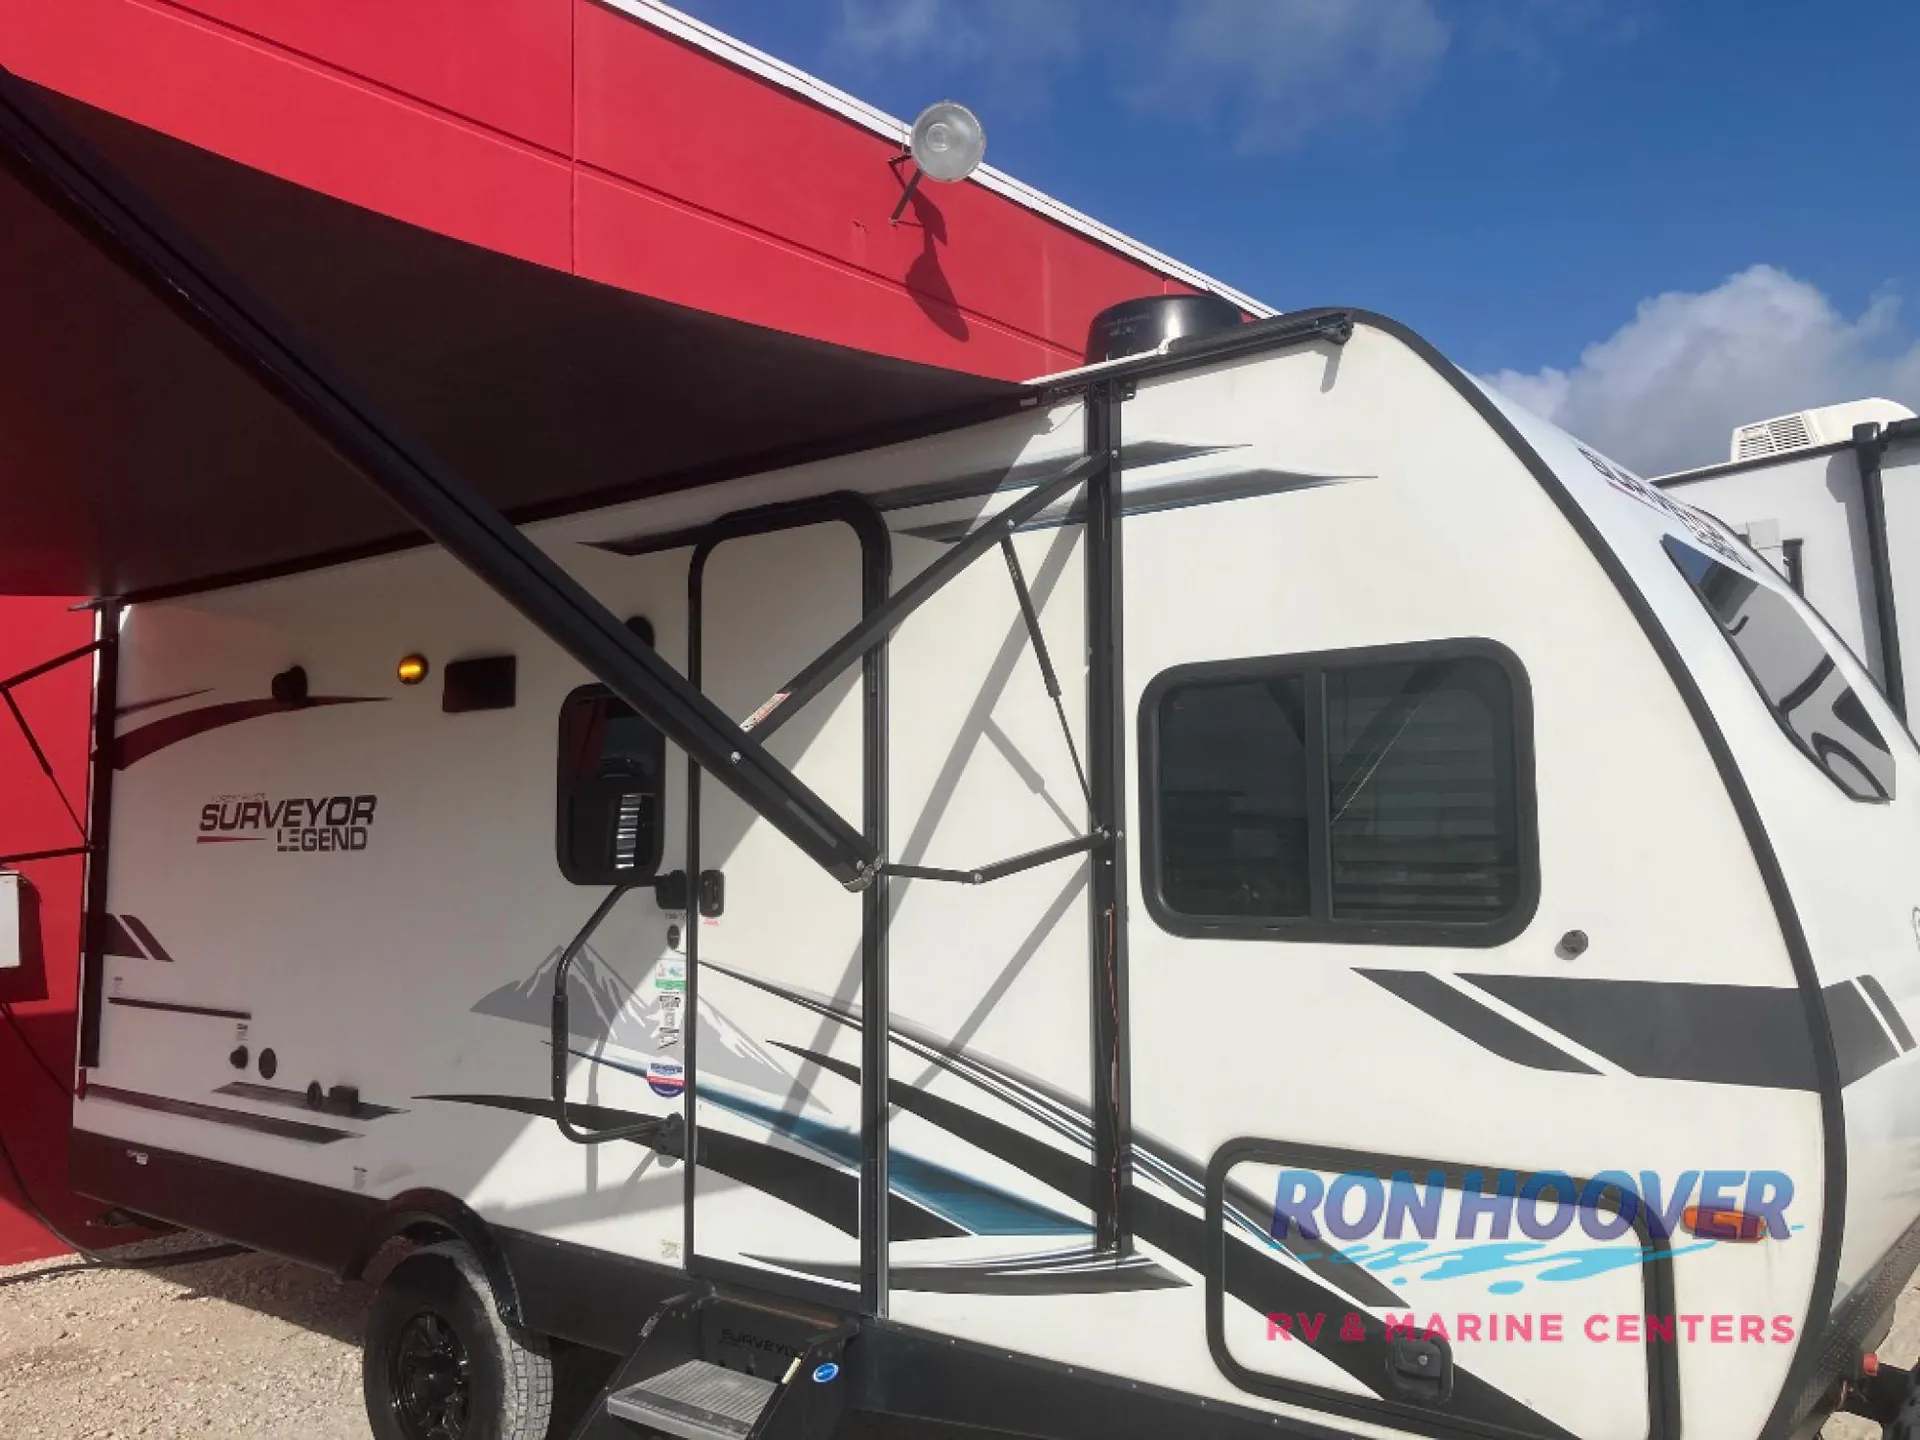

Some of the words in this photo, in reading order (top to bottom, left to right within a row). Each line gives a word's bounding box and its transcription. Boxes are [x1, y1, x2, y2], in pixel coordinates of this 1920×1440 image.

[199, 795, 378, 831] SURVEYOR
[277, 827, 368, 852] LEGEND
[720, 1327, 803, 1359] SURVEYO
